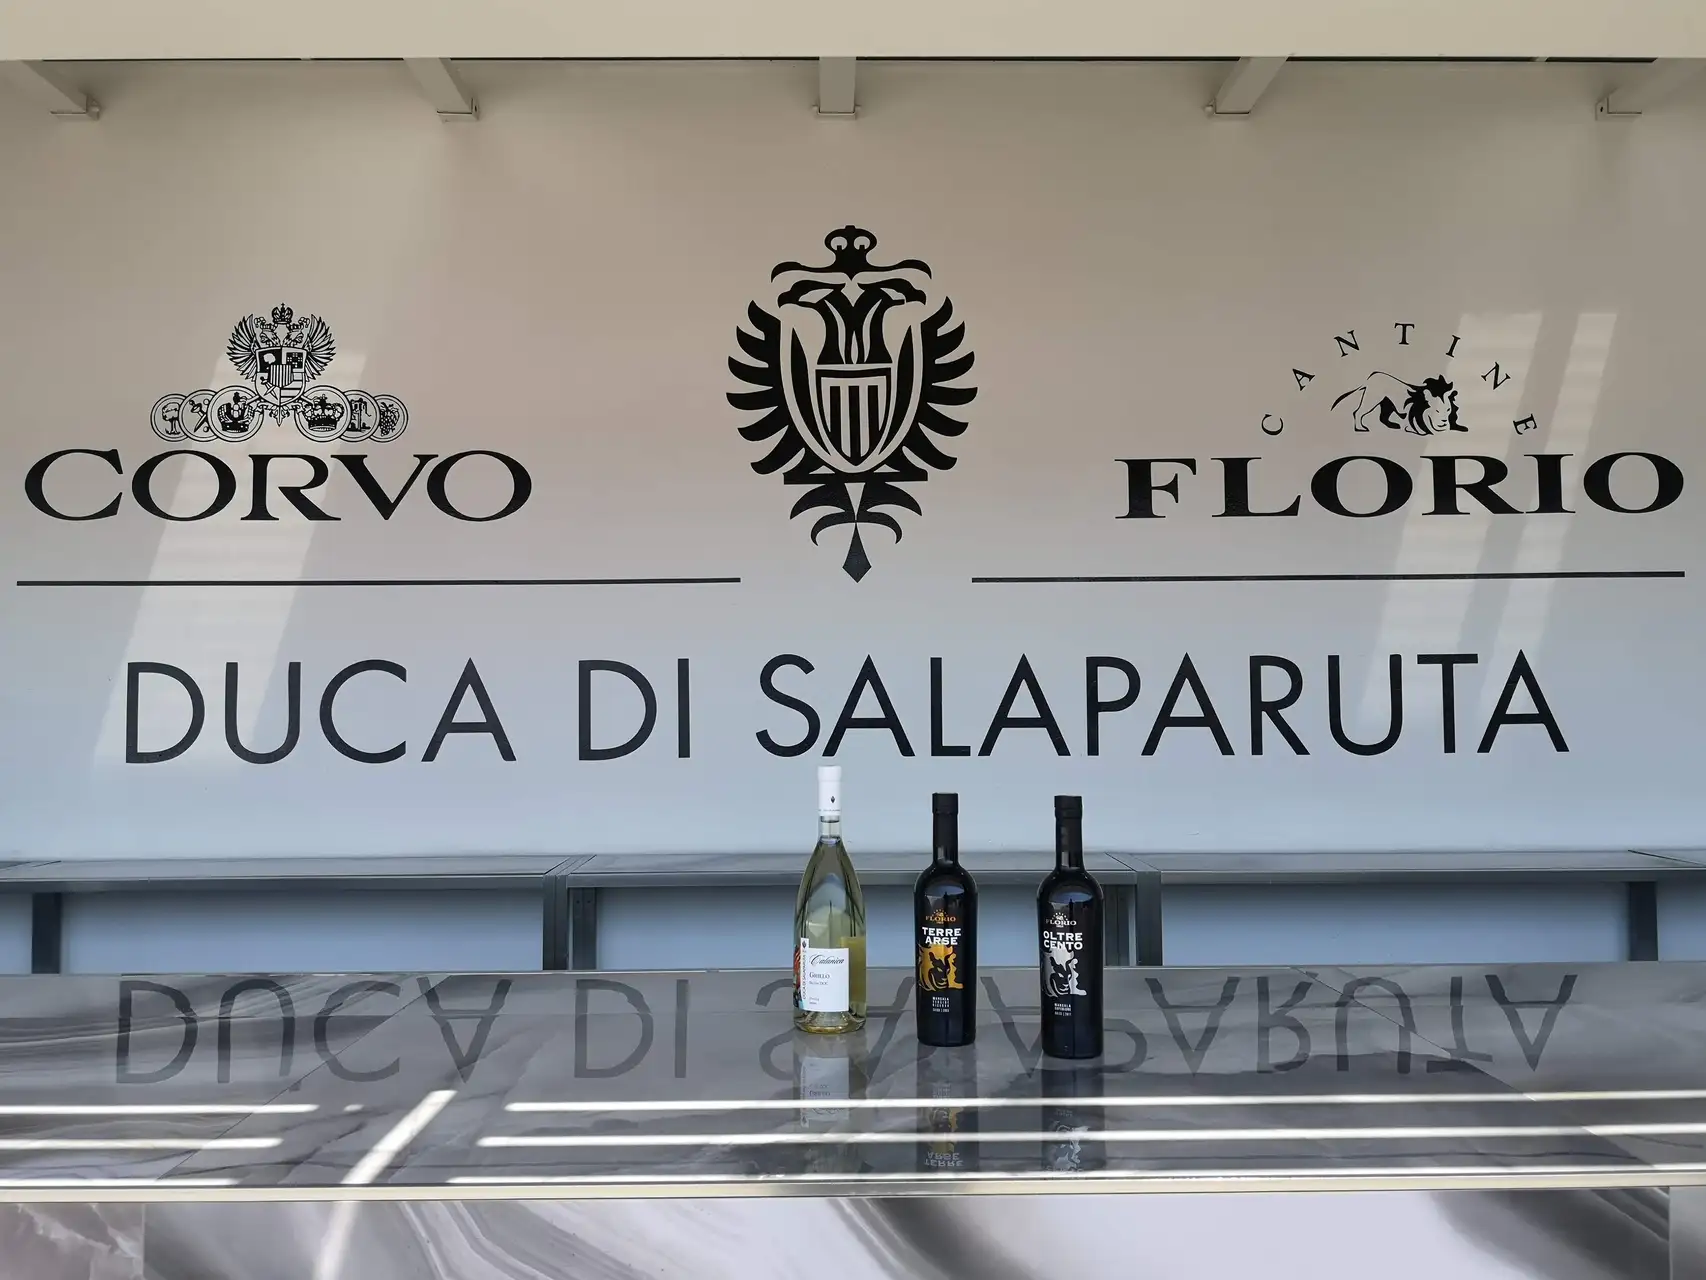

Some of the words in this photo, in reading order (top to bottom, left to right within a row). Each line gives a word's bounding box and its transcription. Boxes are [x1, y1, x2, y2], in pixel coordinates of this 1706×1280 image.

[1261, 322, 1537, 436] CANTINE
[24, 448, 532, 522] CORVO
[1114, 452, 1685, 519] FLORIO
[125, 657, 517, 764] DUCA
[578, 658, 691, 761] DI
[755, 650, 1570, 758] SALAPARUTA
[1045, 918, 1077, 926] FLORIO
[921, 926, 962, 937] TERRE
[1043, 930, 1083, 941] OLTRE
[925, 936, 958, 946] ARSE
[1043, 939, 1083, 951] CENTO
[809, 953, 845, 967] Calanica
